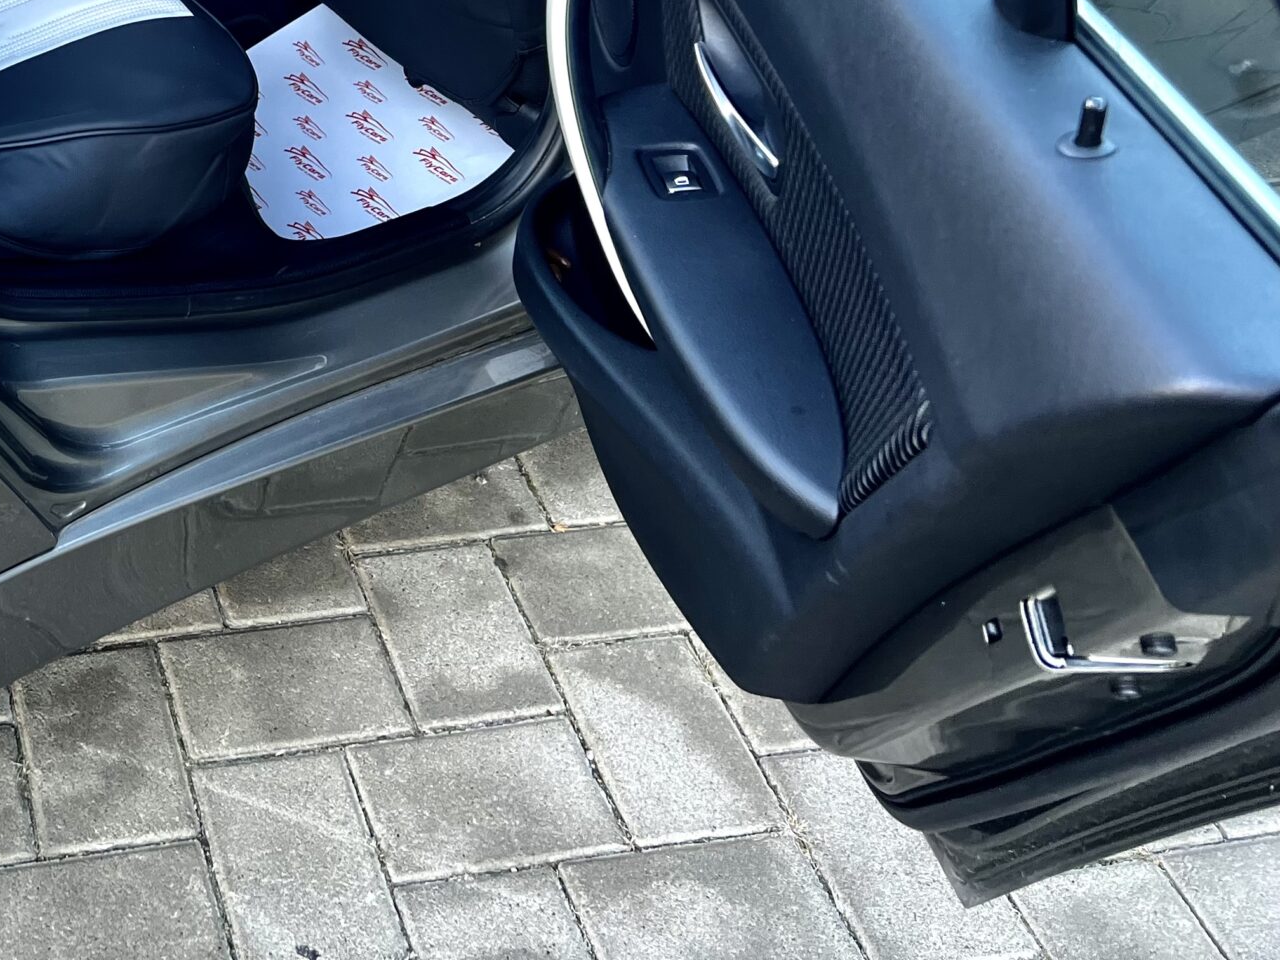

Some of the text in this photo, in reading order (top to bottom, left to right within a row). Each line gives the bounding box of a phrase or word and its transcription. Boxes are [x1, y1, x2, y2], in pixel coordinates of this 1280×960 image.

[351, 120, 388, 142] FlyCars
[289, 155, 326, 179] FlyCars
[419, 157, 458, 183] FlyCars
